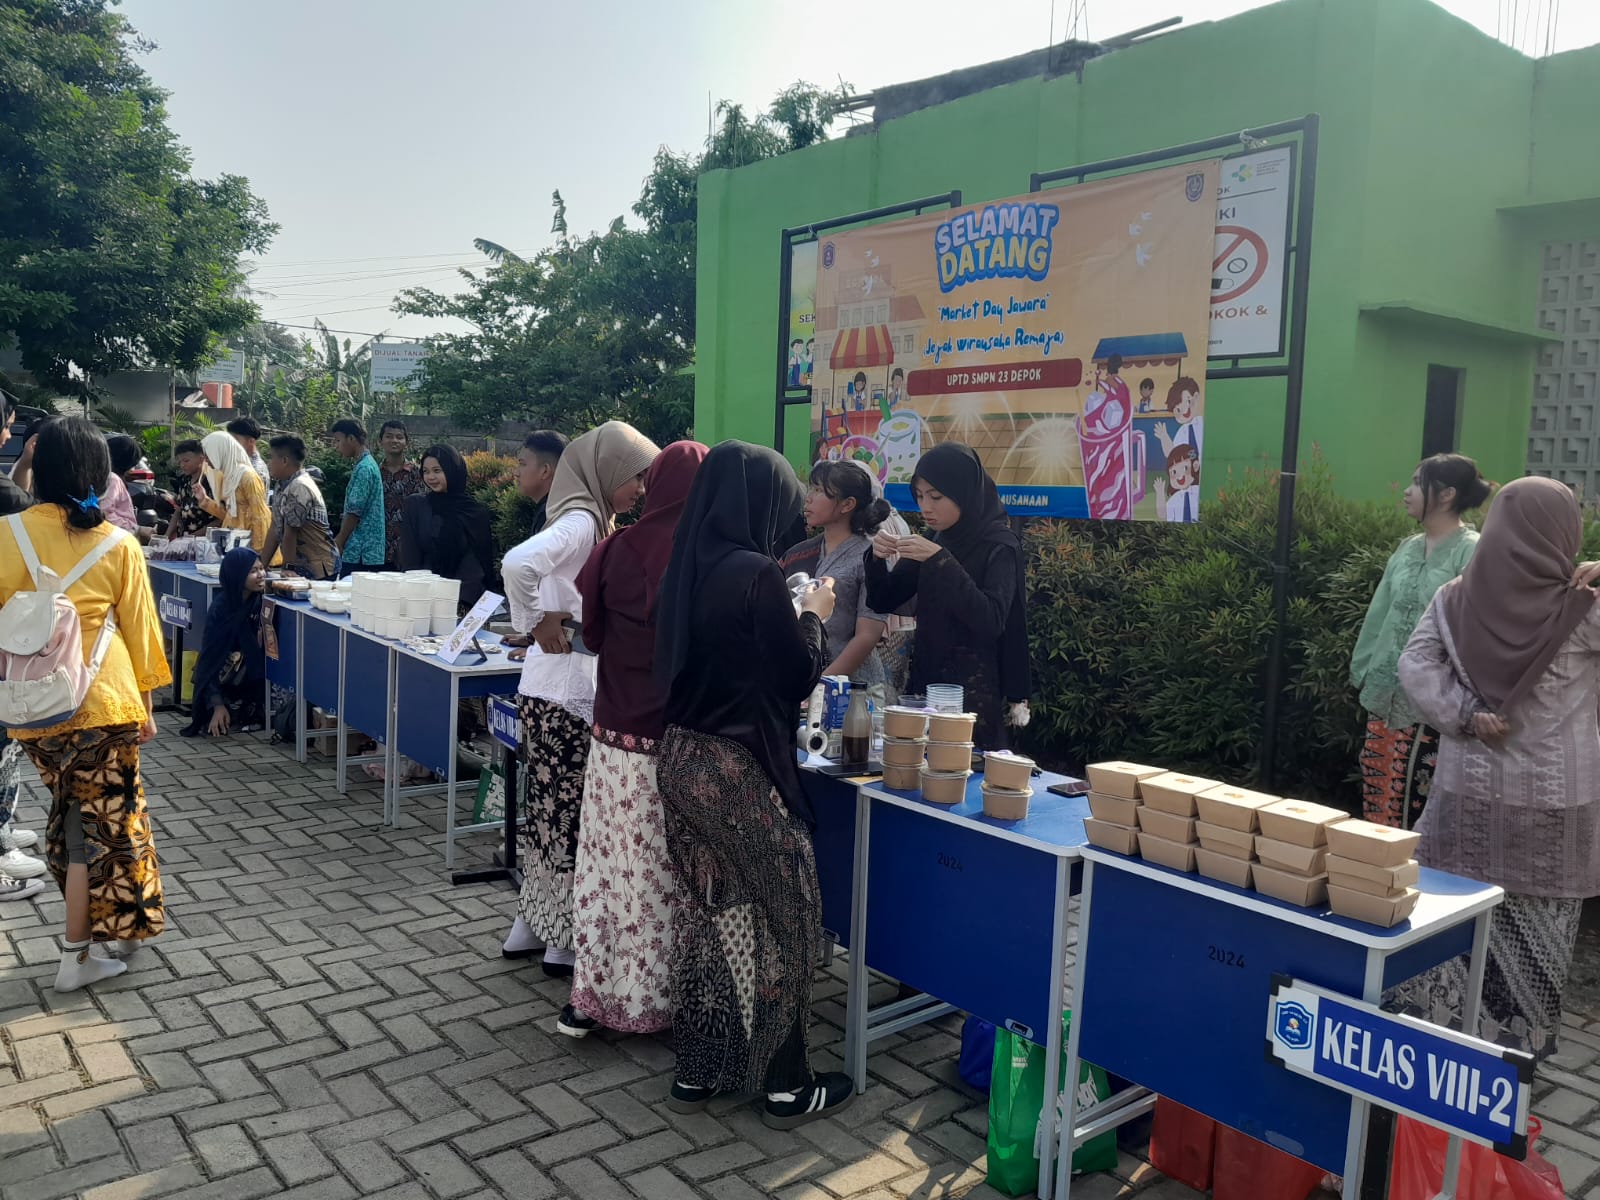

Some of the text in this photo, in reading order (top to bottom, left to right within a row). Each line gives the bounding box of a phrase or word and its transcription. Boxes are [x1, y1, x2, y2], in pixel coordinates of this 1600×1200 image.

[1216, 207, 1236, 220] KI
[936, 206, 1057, 254] SELAMAT
[939, 237, 1050, 285] DATANG
[983, 299, 1003, 324] Day
[1209, 304, 1268, 320] KOK &
[947, 367, 1042, 386] UPTD SMPN 23 DEPOK
[936, 851, 963, 873] 2024
[1208, 945, 1245, 969] 2024
[1322, 1016, 1513, 1127] KELAS VIII-2
